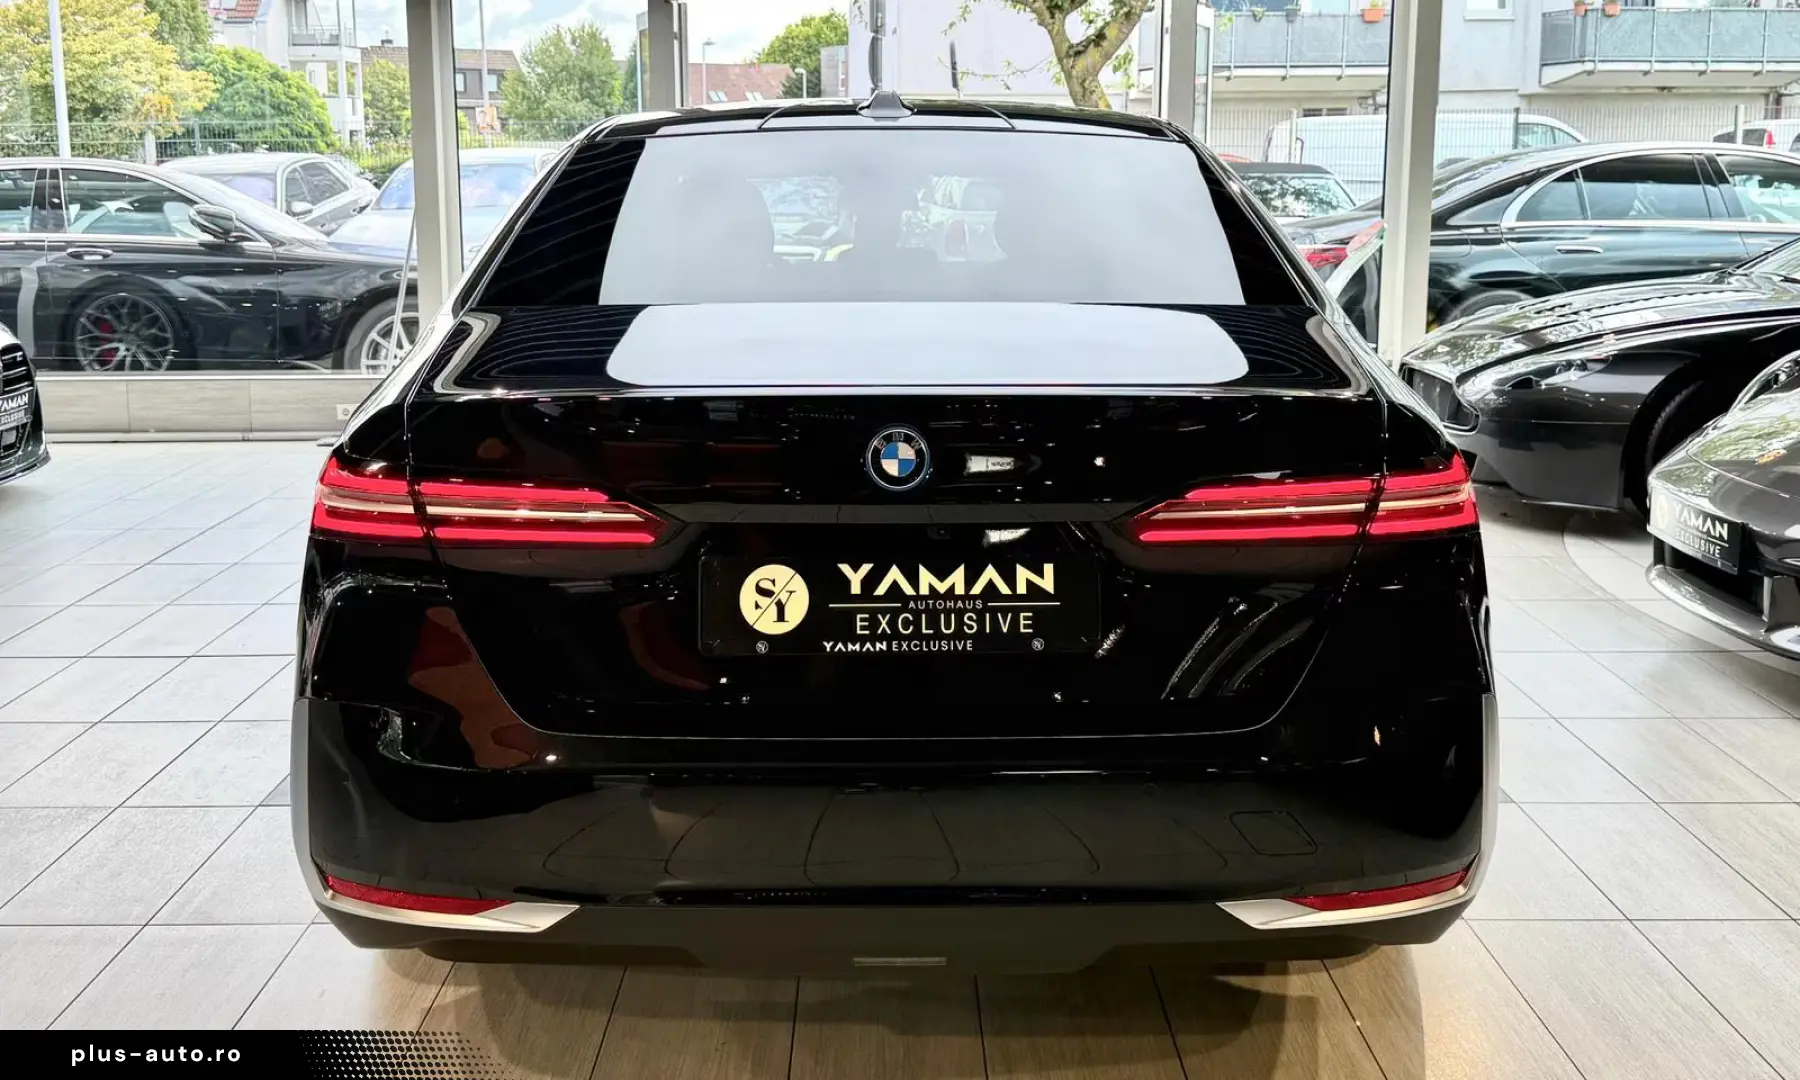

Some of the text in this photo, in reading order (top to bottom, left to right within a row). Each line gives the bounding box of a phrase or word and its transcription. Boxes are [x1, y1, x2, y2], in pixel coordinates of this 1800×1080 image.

[874, 431, 922, 451] BMW
[1674, 499, 1728, 541] YAMAN
[837, 563, 1054, 595] YAMAN
[908, 600, 983, 610] AUTOHAUS
[856, 612, 1034, 634] EXCLUSIVE
[823, 640, 973, 653] YAMAN EXCLUSIVE
